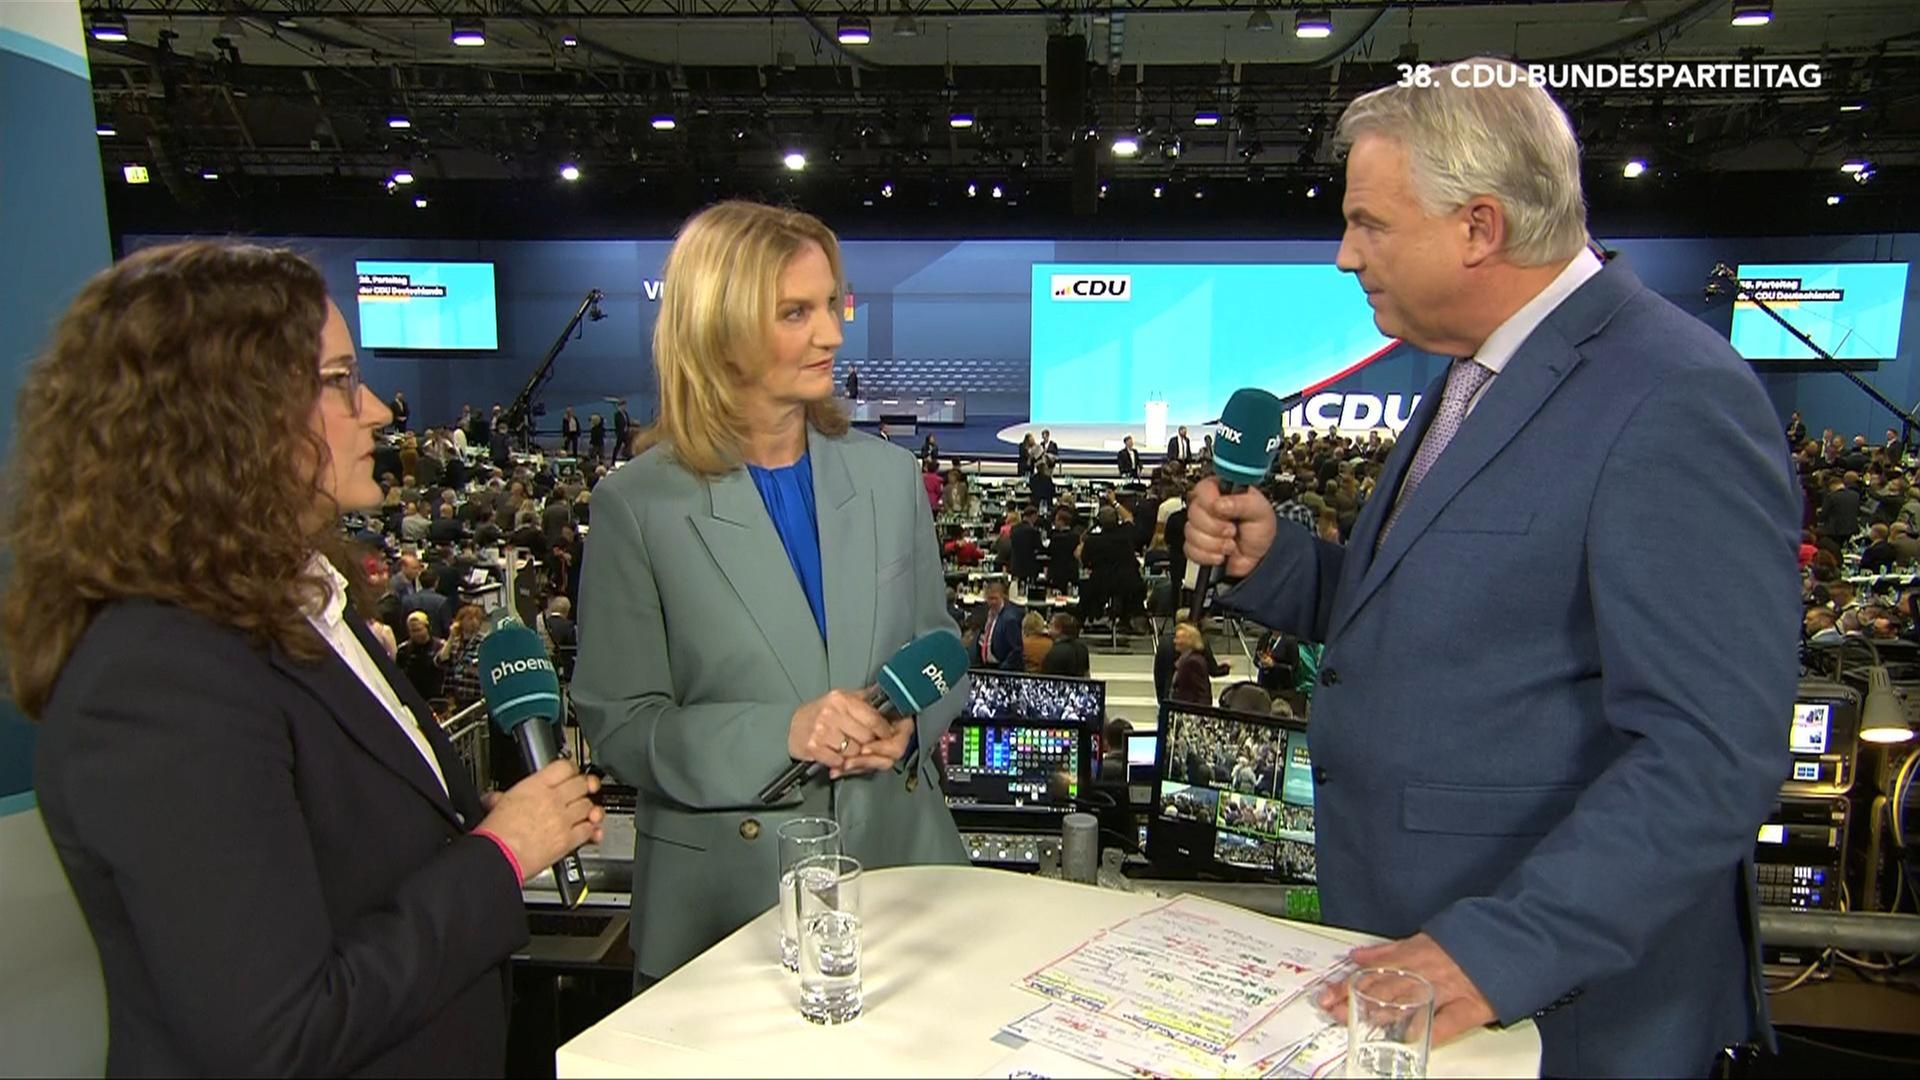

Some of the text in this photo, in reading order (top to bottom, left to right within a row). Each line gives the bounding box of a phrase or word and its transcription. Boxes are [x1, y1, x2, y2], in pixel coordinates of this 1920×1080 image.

[1073, 280, 1126, 296] CDU
[1755, 280, 1799, 290] Parteitag
[1754, 291, 1776, 300] CDU
[1776, 291, 1841, 300] Deutschlands
[1305, 392, 1422, 430] CDU
